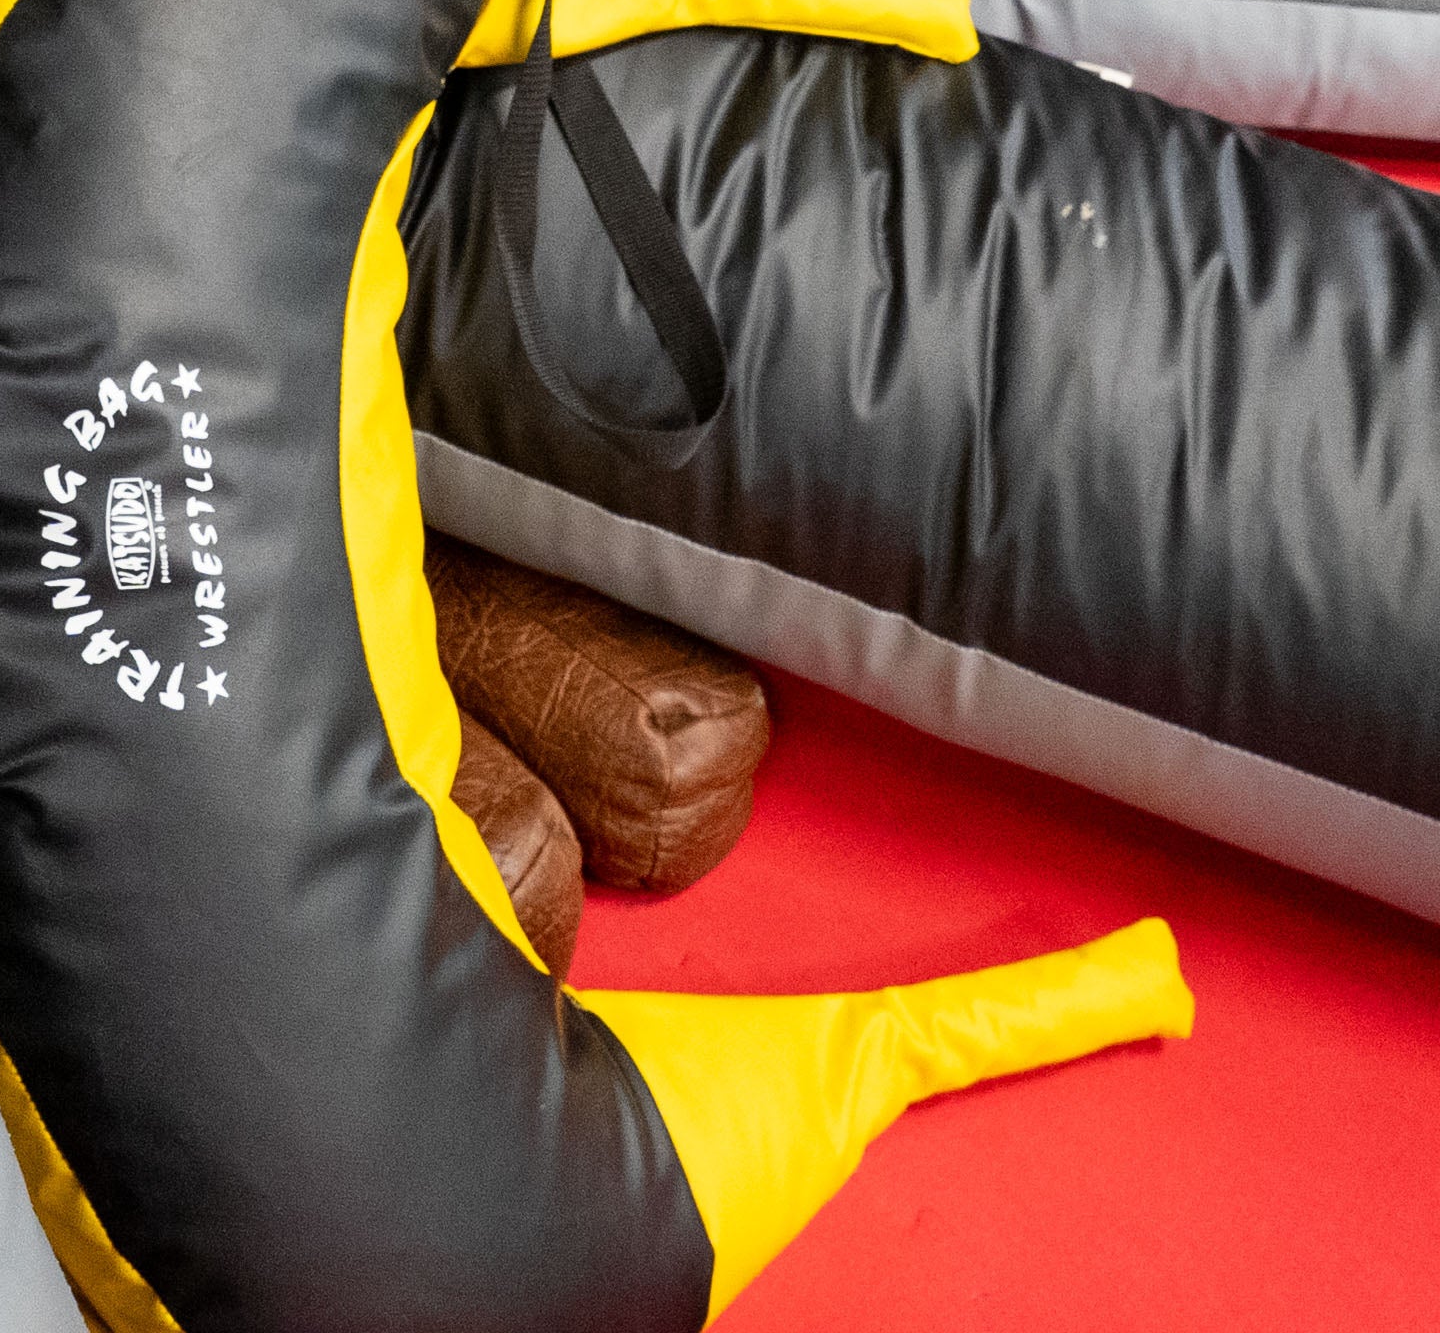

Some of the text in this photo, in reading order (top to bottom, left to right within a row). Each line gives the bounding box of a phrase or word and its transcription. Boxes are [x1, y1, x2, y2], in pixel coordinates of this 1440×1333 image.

[39, 359, 187, 711] TRAINING BAG
[110, 482, 151, 585] KATSUDO
[180, 411, 229, 648] WRESTLER
